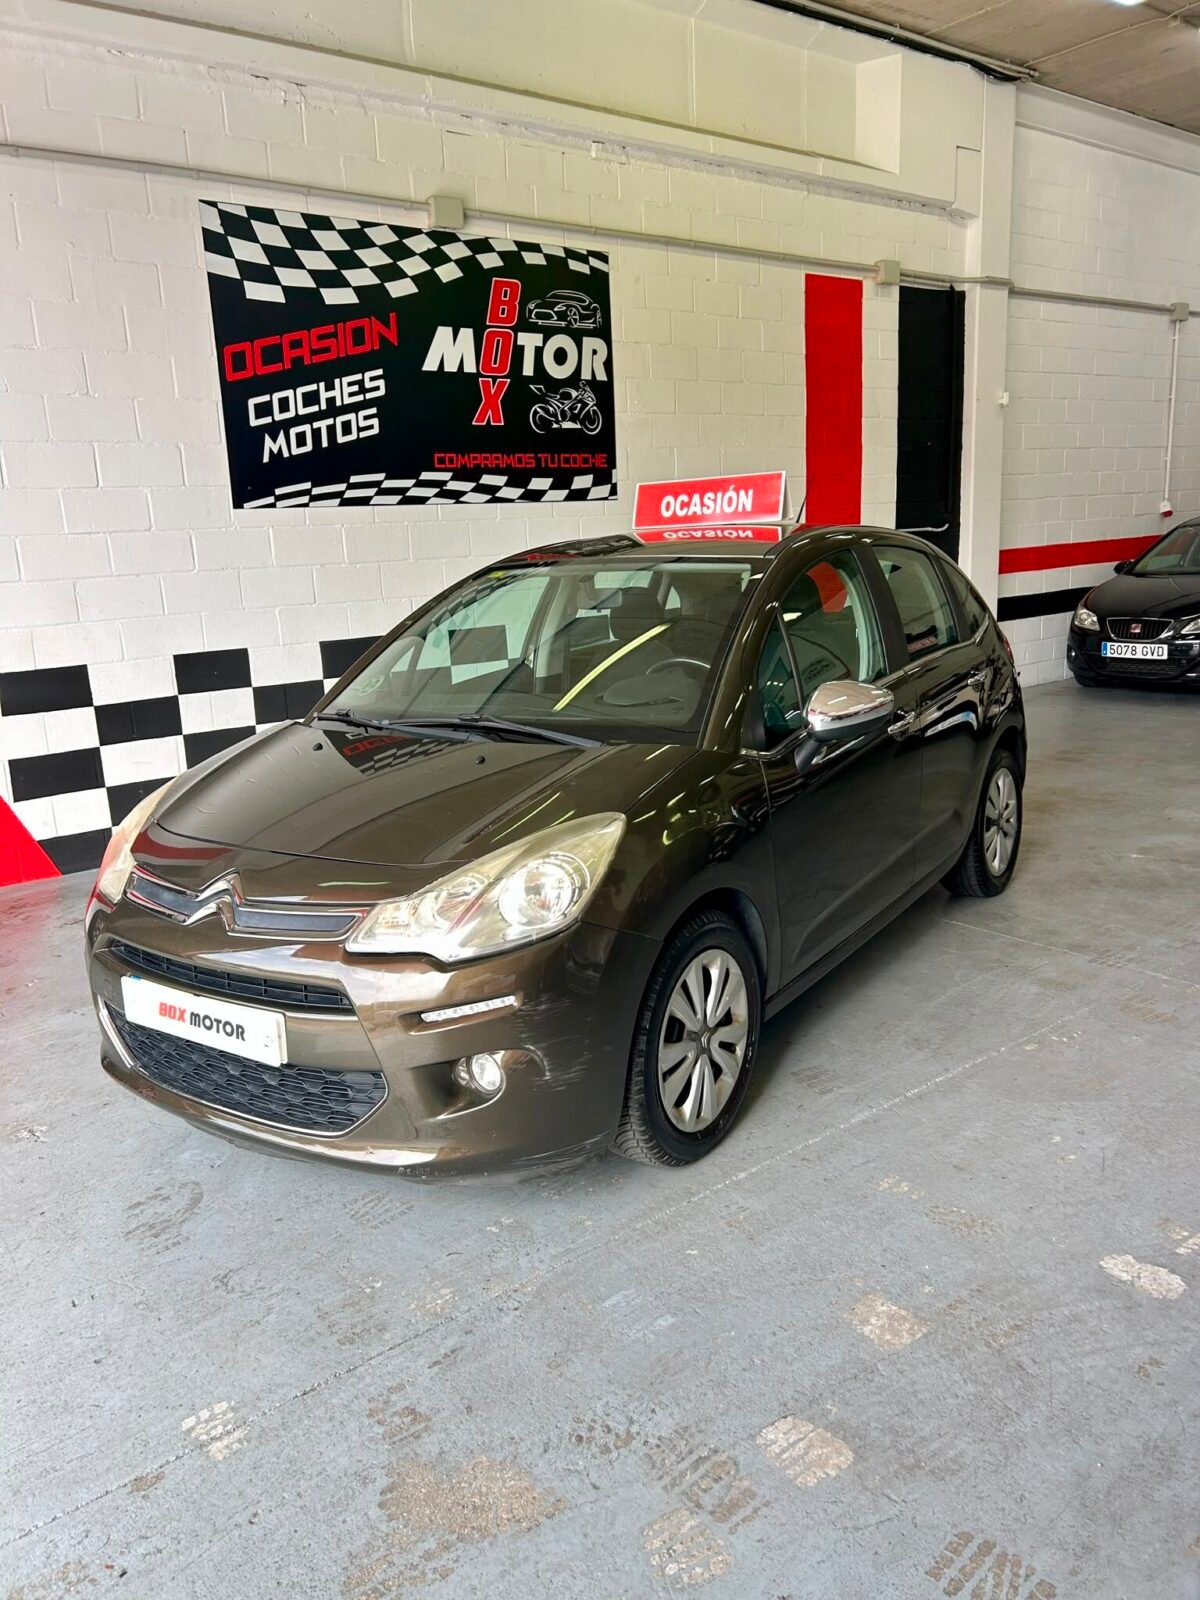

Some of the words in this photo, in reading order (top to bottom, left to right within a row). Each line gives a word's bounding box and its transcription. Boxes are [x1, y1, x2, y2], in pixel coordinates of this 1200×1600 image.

[223, 312, 398, 382] OCASION
[472, 277, 521, 425] BOX
[247, 368, 386, 428] COCHES
[262, 407, 380, 464] MOTOS
[434, 453, 536, 468] COMPRAMOS
[538, 453, 558, 468] TU
[560, 453, 608, 468] COCHE
[660, 484, 754, 518] OCASIÓN
[1109, 644, 1137, 656] 5078
[1141, 645, 1164, 657] GVD
[159, 1002, 187, 1023] BOX
[189, 1011, 246, 1042] MOTOR
